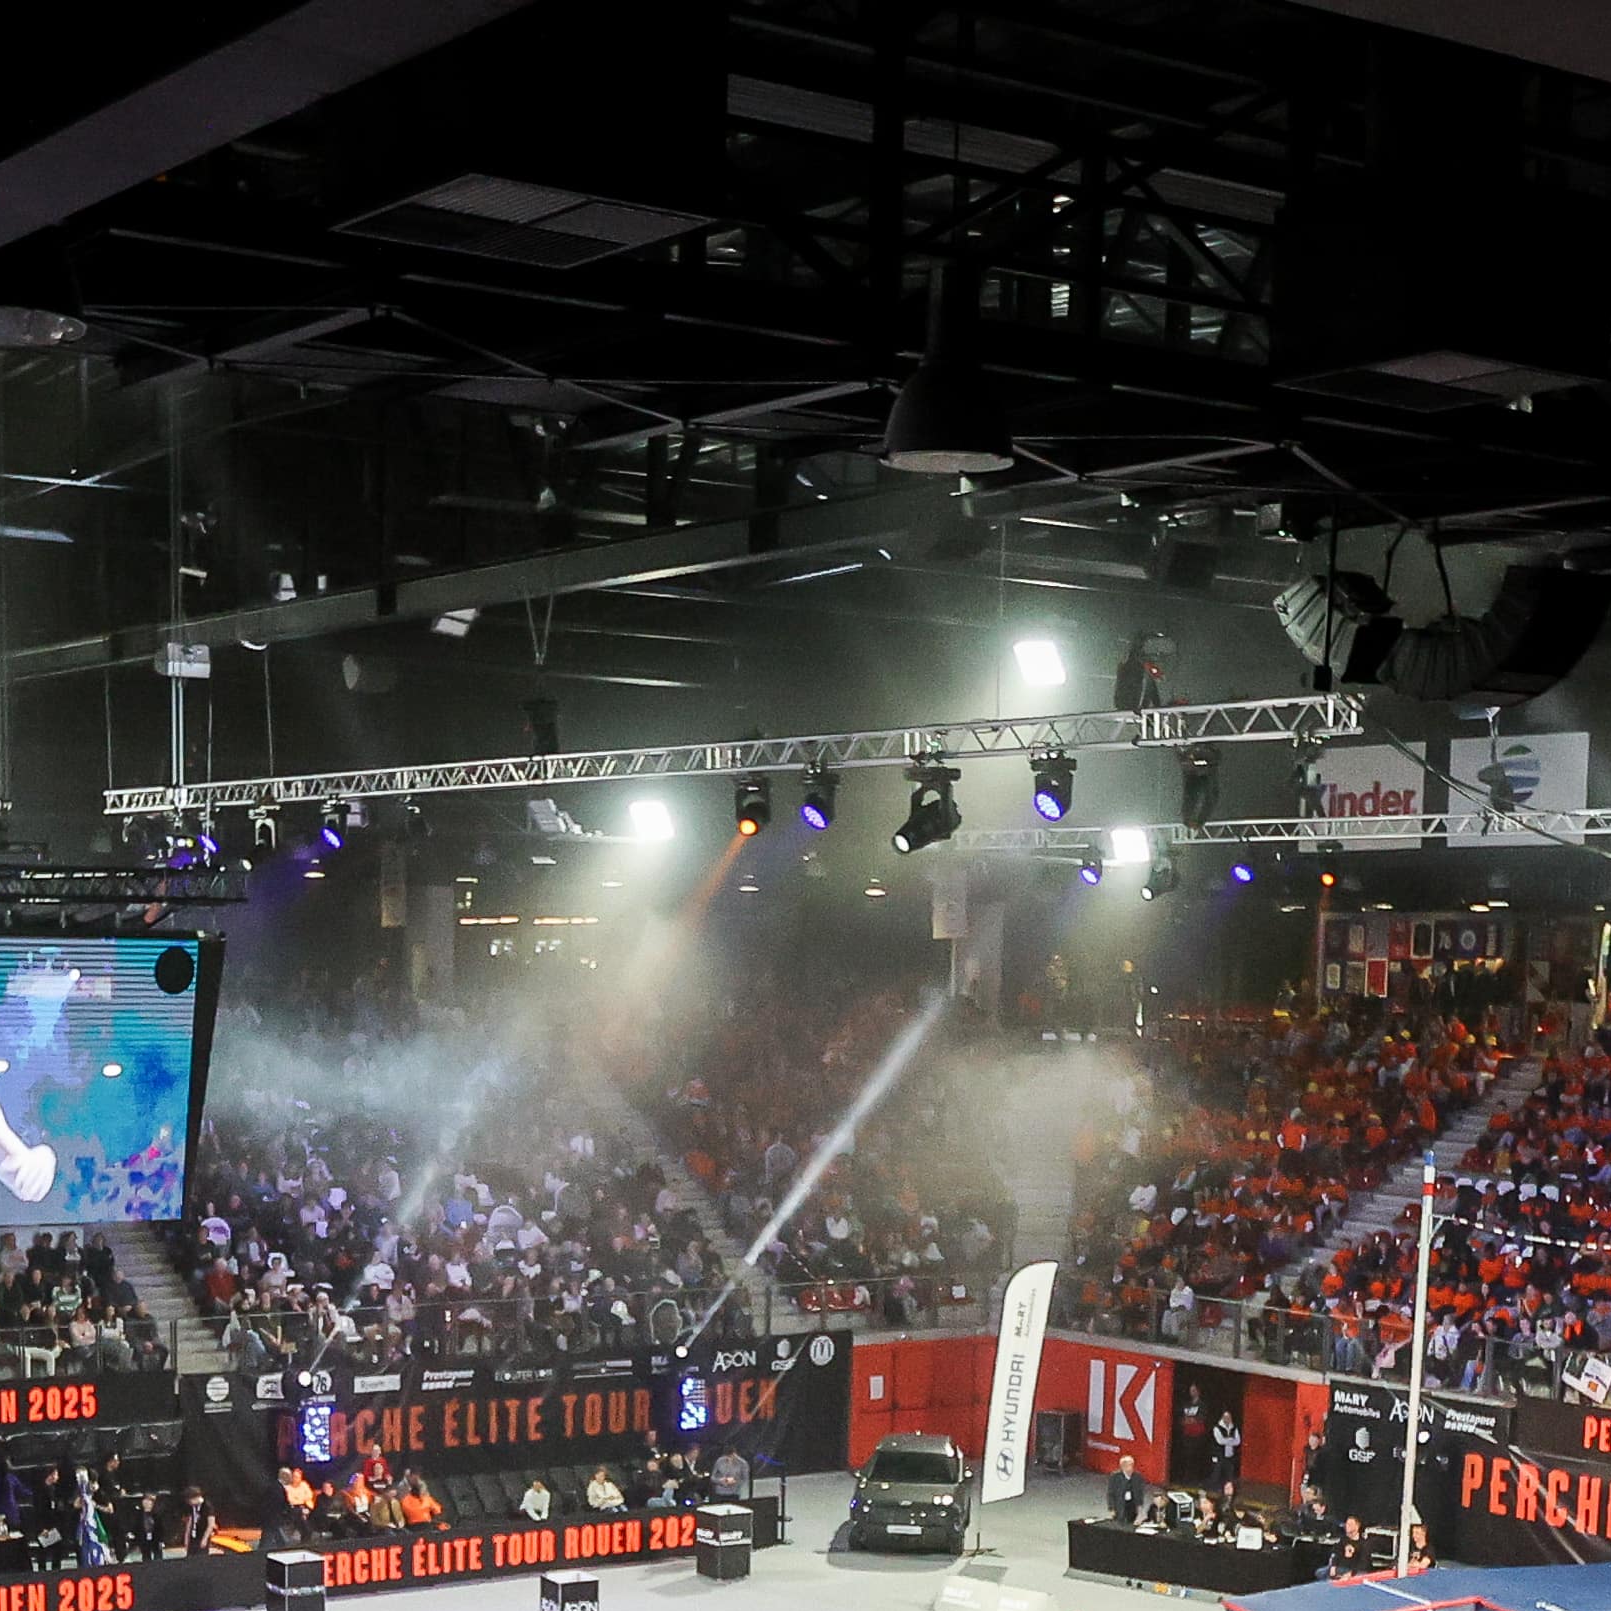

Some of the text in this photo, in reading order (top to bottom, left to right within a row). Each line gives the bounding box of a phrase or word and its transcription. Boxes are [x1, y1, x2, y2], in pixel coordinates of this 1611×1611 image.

[712, 1350, 757, 1373] AGON
[28, 1383, 98, 1422] 2025
[1000, 1353, 1026, 1443] HYUNDAI
[1334, 1390, 1370, 1407] MARY
[277, 1404, 428, 1461] PRCHE
[561, 1388, 651, 1438] TOUR
[715, 1378, 779, 1424] UEN
[1348, 1449, 1376, 1463] GSF
[324, 1514, 696, 1588] ERCHE ÉLITE TOUR ROUEN 202
